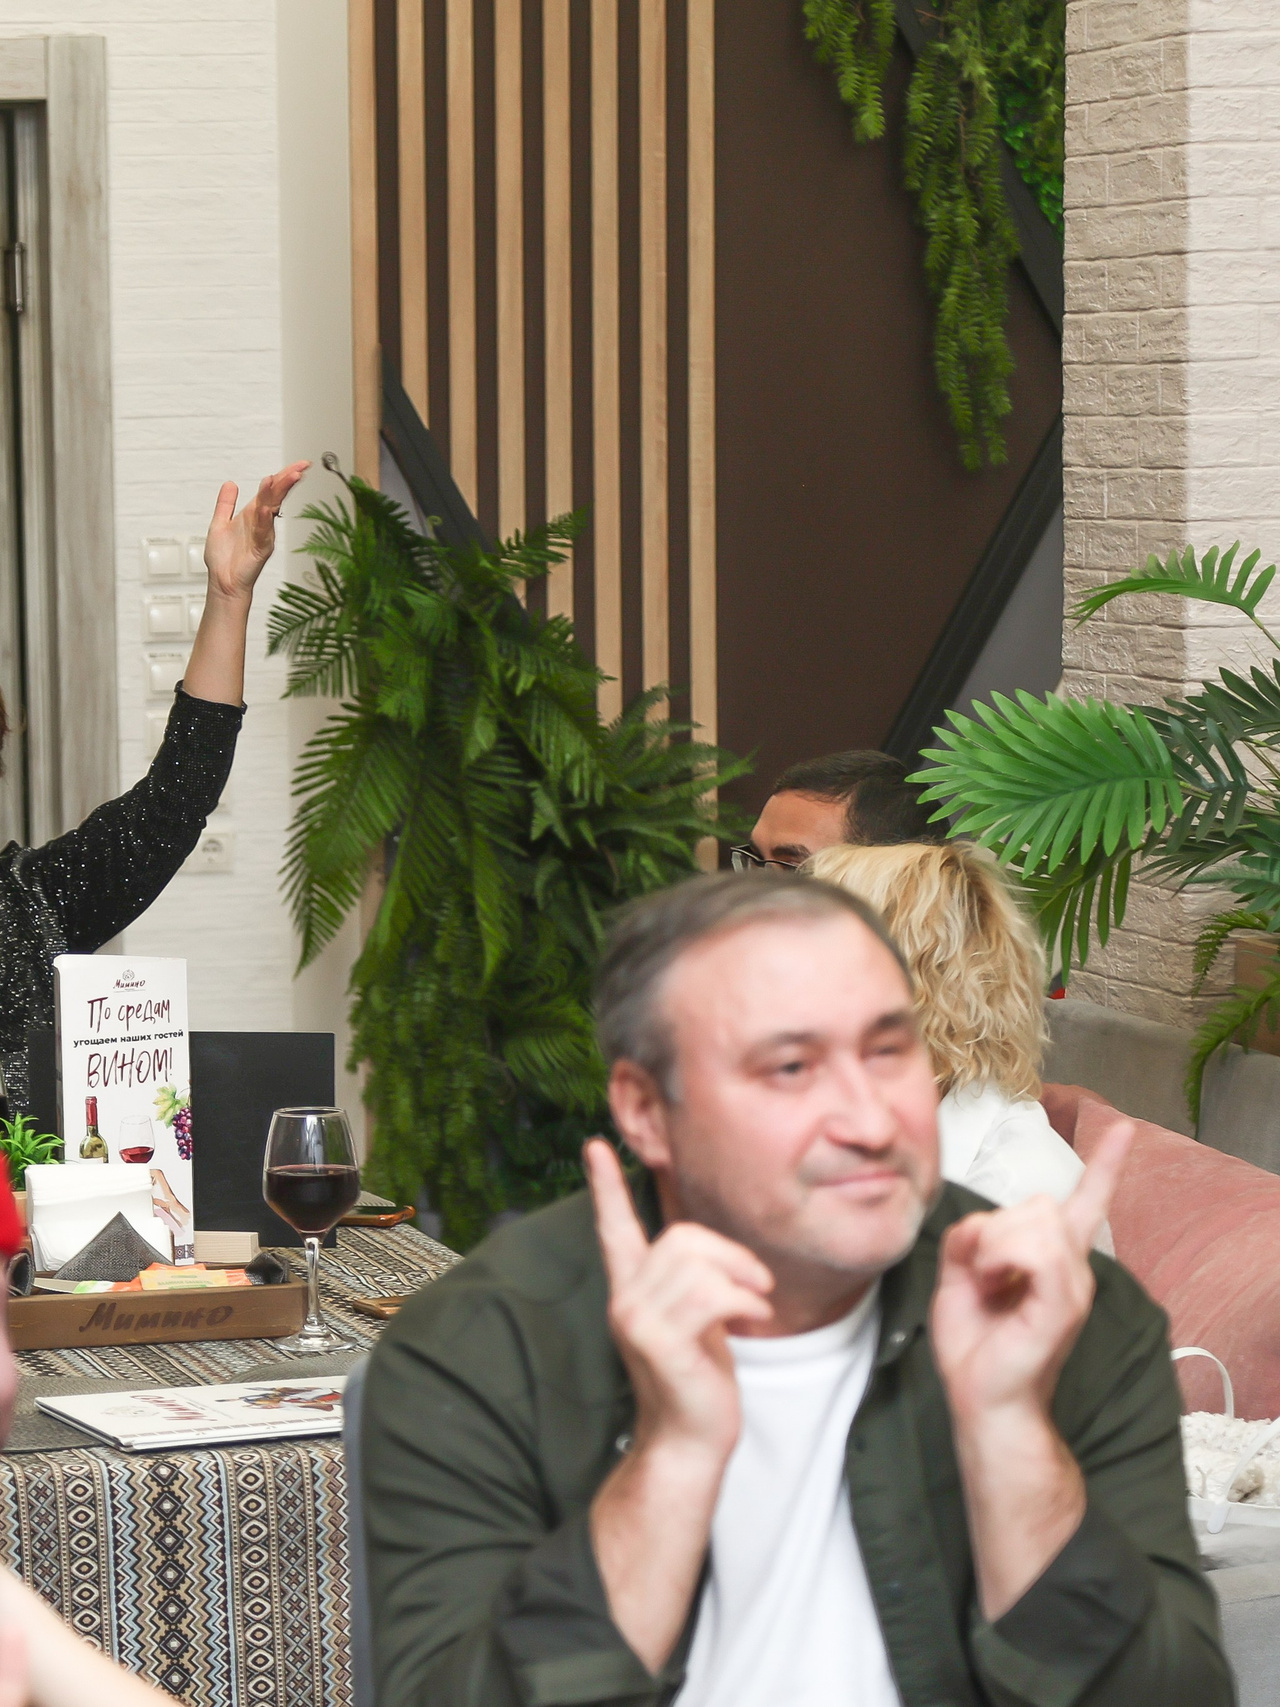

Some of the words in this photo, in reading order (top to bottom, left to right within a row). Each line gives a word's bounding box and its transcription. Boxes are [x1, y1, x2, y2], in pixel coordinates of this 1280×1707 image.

[87, 997, 111, 1033] По
[118, 999, 171, 1032] средам
[73, 1037, 118, 1048] угощаем
[120, 1034, 152, 1043] наших
[154, 1029, 184, 1040] гостей
[87, 1047, 173, 1089] ВИНОМ!
[78, 1302, 234, 1333] Мимино
